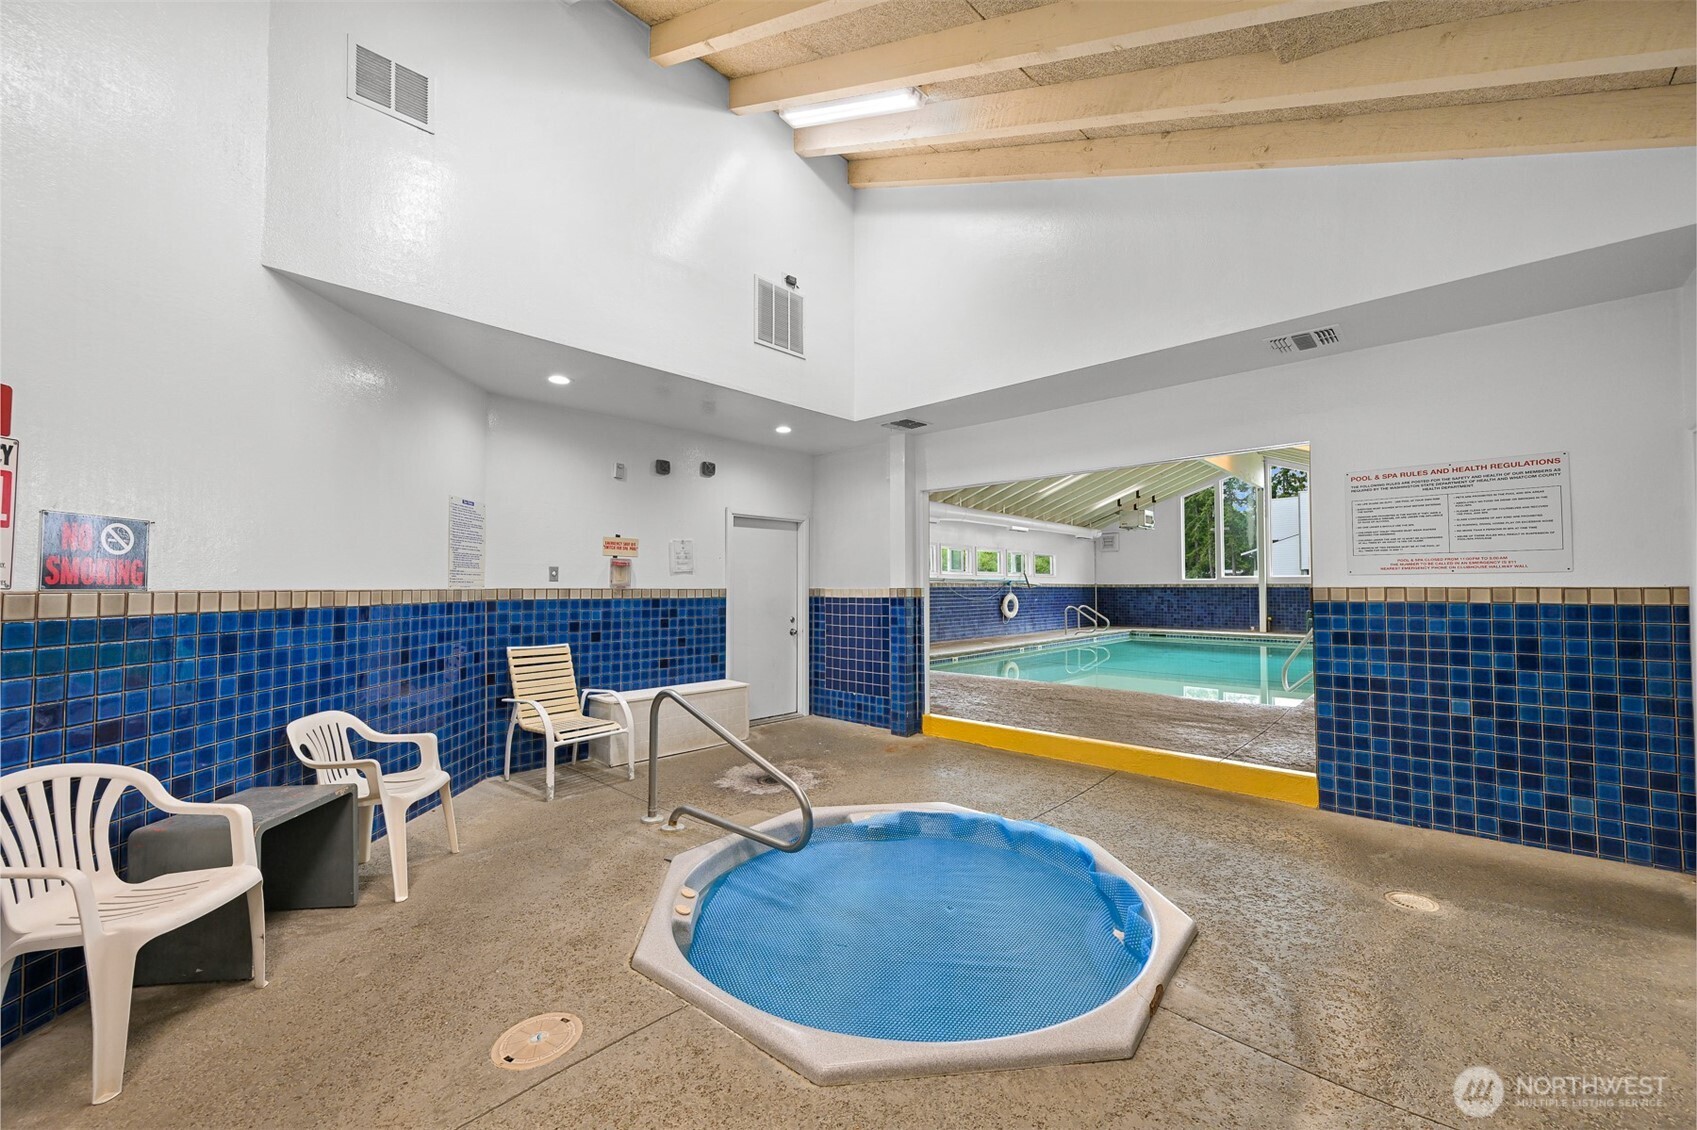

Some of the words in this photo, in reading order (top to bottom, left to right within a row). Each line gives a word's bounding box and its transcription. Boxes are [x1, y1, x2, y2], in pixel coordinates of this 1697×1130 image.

[1400, 469, 1428, 478] RULES
[1452, 464, 1487, 473] HEALTH
[1490, 458, 1561, 470] REGULATIONS
[61, 521, 92, 552] NO
[44, 555, 145, 586] SMOKING
